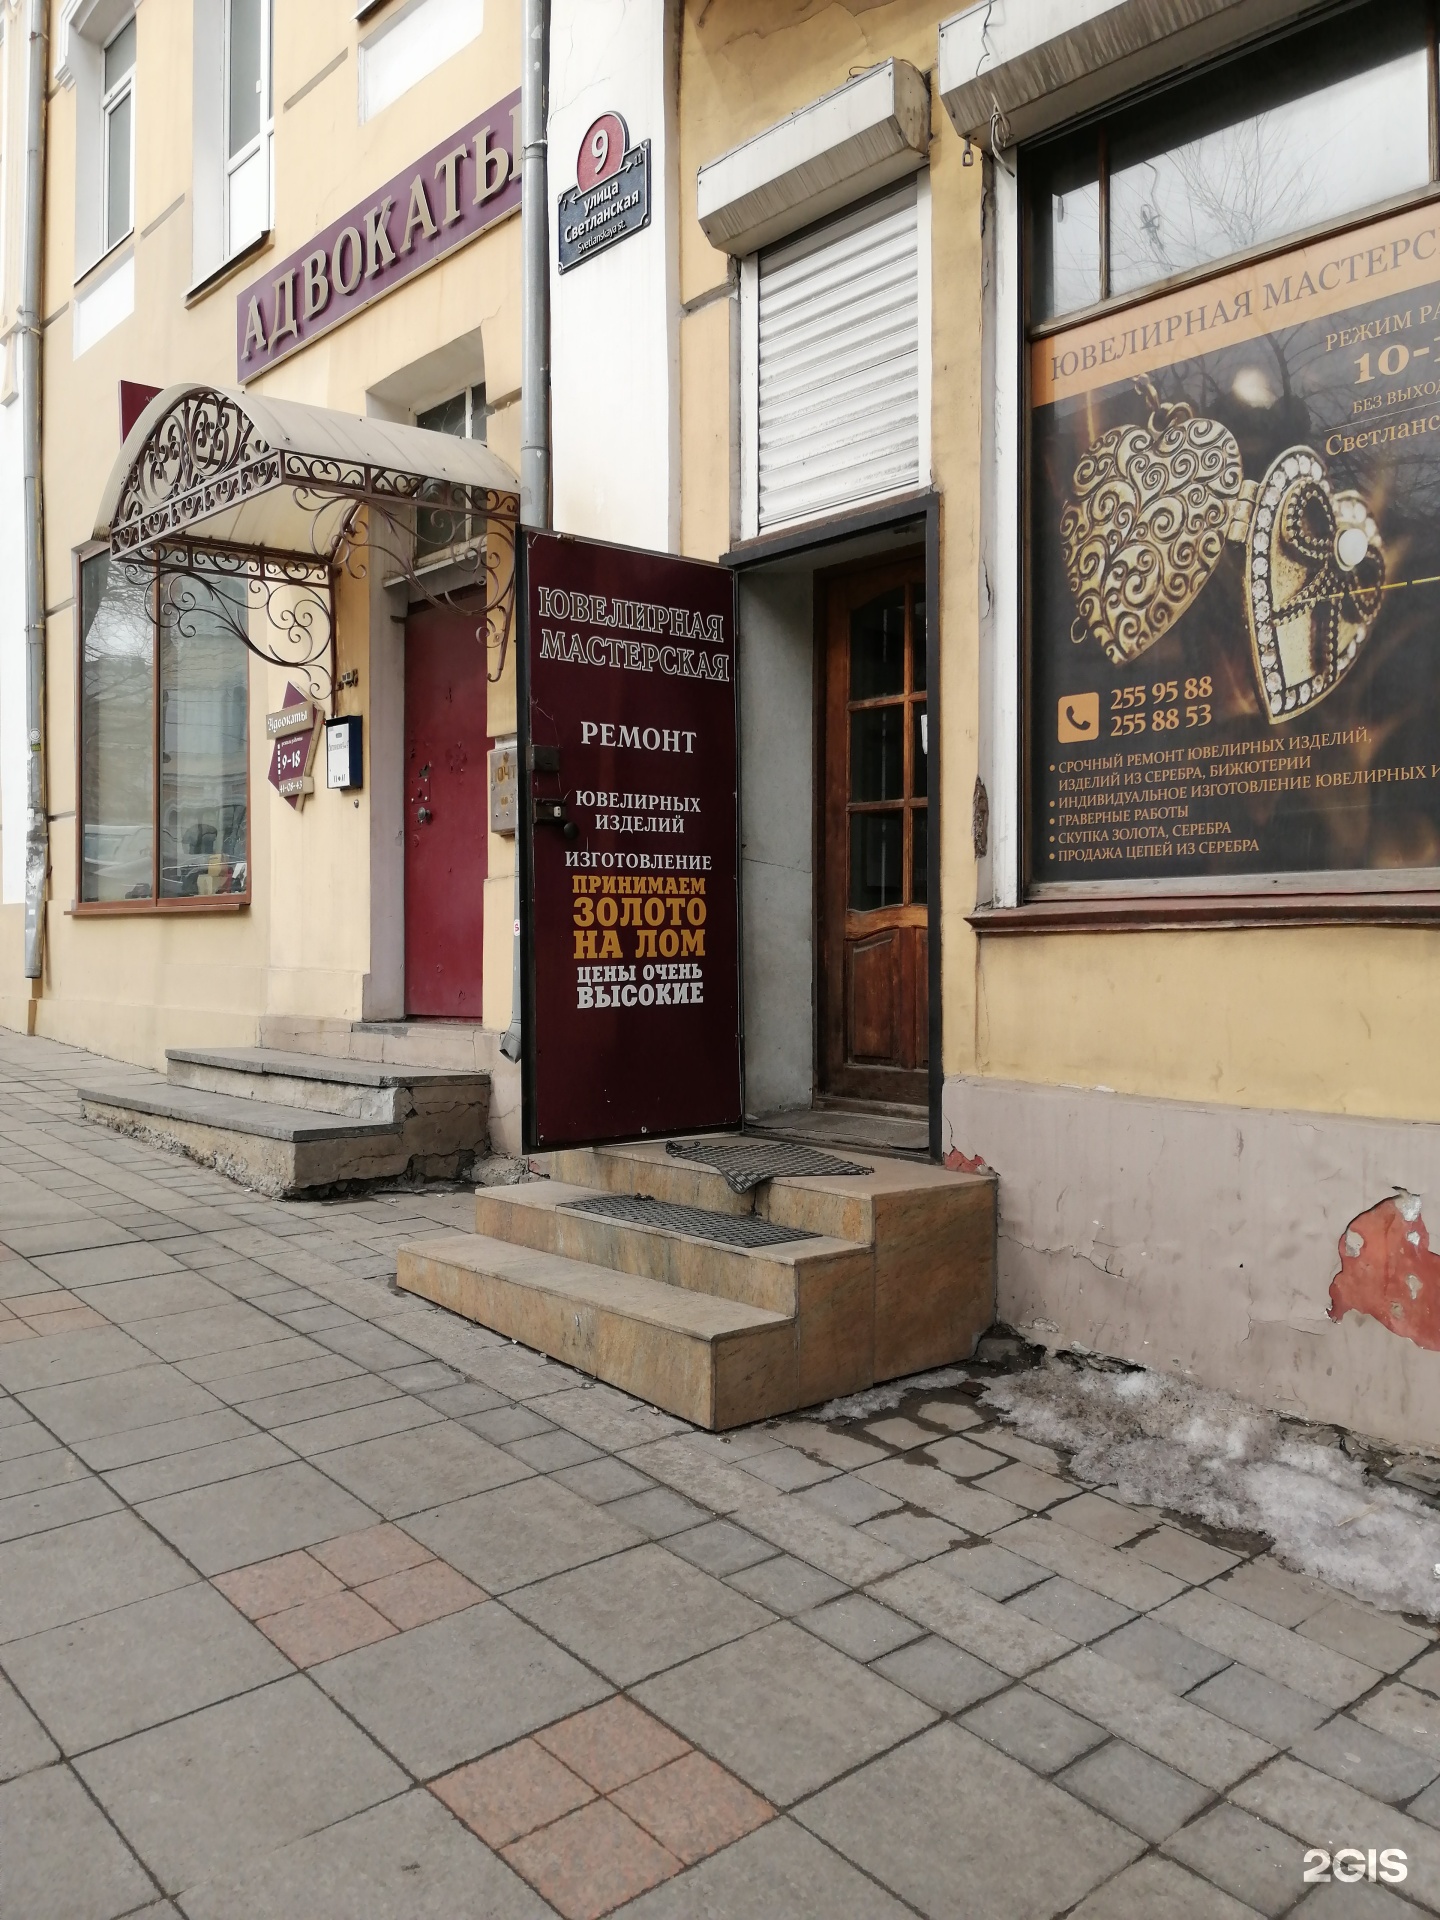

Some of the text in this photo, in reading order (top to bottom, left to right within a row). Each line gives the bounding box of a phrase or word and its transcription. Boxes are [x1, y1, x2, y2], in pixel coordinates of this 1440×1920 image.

[592, 129, 609, 174] 9
[634, 153, 643, 167] 11
[584, 181, 619, 217] улица
[564, 190, 639, 243] Светланская
[578, 225, 617, 253] Svetlanskaya
[1051, 227, 1440, 382] ЮВЕЛИРНАЯ МАСТЕРС
[1325, 309, 1412, 352] РЕЖИМ
[1354, 336, 1440, 385] 10-
[1353, 379, 1440, 415] БЕЗ ВЫХО
[1325, 414, 1440, 456] Светланс
[538, 586, 724, 642] ЮВЕЛИРНАЯ
[540, 629, 729, 682] МАСТЕРСКАЯ
[1110, 676, 1213, 710] 255 95 88
[1110, 704, 1212, 736] 255 88 53
[581, 721, 697, 753] РЕМОНТ
[1058, 726, 1372, 774] СРОЧНЫЙ РЕМОНТ ЮВЕЛИРНЫХ ИЗДЕЛИЙ,
[282, 750, 301, 770] 9-18
[1058, 756, 1312, 792] ИЗДЕЛИЙ ИЗ СЕРЕБРА, БИЖЮТЕРИИ
[576, 790, 701, 813] ЮВЕЛИРНЫХ
[1058, 787, 1187, 809] ИНДИВИДУАЛЬНОЕ
[1191, 776, 1311, 798] ИЗГОТОВЛЕНИЕ
[1315, 765, 1427, 788] ЮВЕЛИРНЫХ
[595, 815, 684, 833] ИЗДЕЛИЙ
[1058, 805, 1189, 826] ГРАВЕРНЫЕ РАБОТЫ
[1058, 821, 1232, 844] СКУПКА ЗОЛОТА, СЕРЕБРА
[565, 851, 712, 871] ИЗГОТОВЛЕНИЕ
[1058, 839, 1260, 862] ПРОДАЖА ЦЕПЕЙ ИЗ СЕРЕБРА
[572, 875, 706, 895] ПРИНИМАЕМ
[573, 897, 707, 927] ЗОЛОТО
[573, 929, 706, 959] НА ЛОМ
[577, 963, 703, 986] ЦЕНЫ ОЧЕНЬ
[577, 982, 704, 1009] ВЫСОКИЕ
